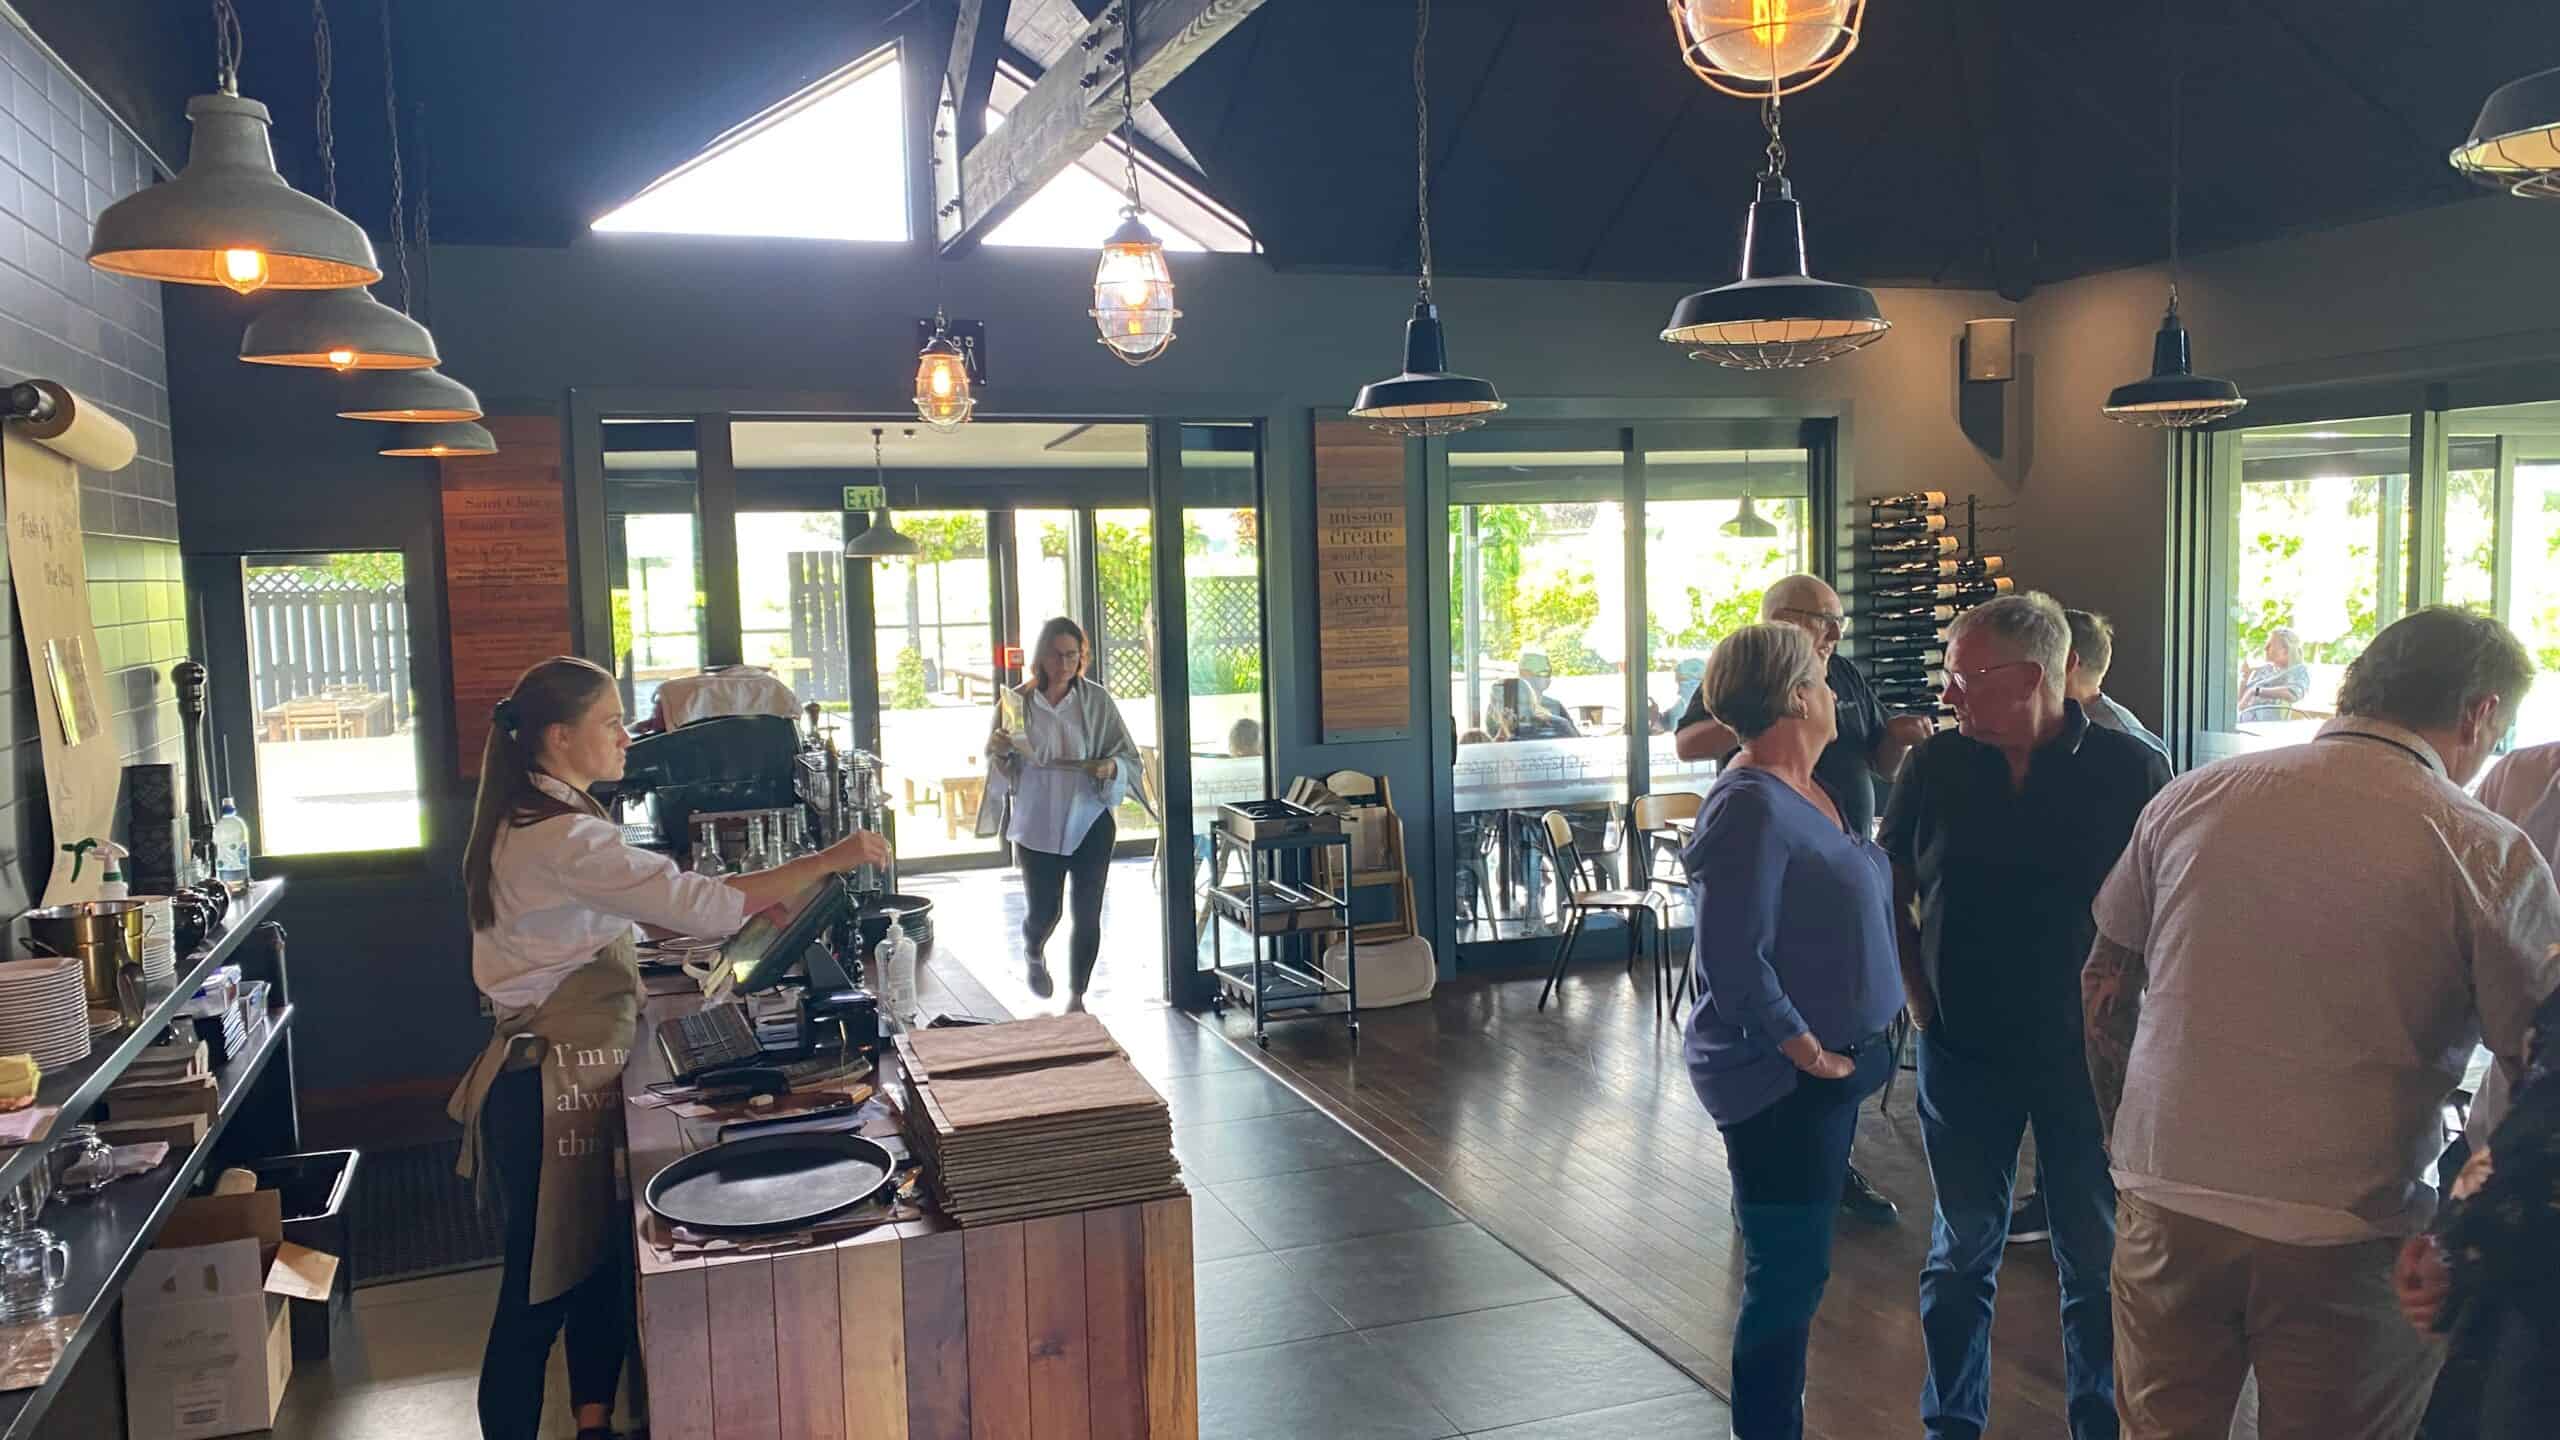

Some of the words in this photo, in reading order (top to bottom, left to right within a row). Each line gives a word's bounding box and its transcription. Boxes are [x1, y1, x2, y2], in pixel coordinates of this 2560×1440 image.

[1328, 507, 1393, 526] mission
[1328, 527, 1393, 546] create
[1333, 568, 1395, 586] wines
[553, 1043, 607, 1067] I'm
